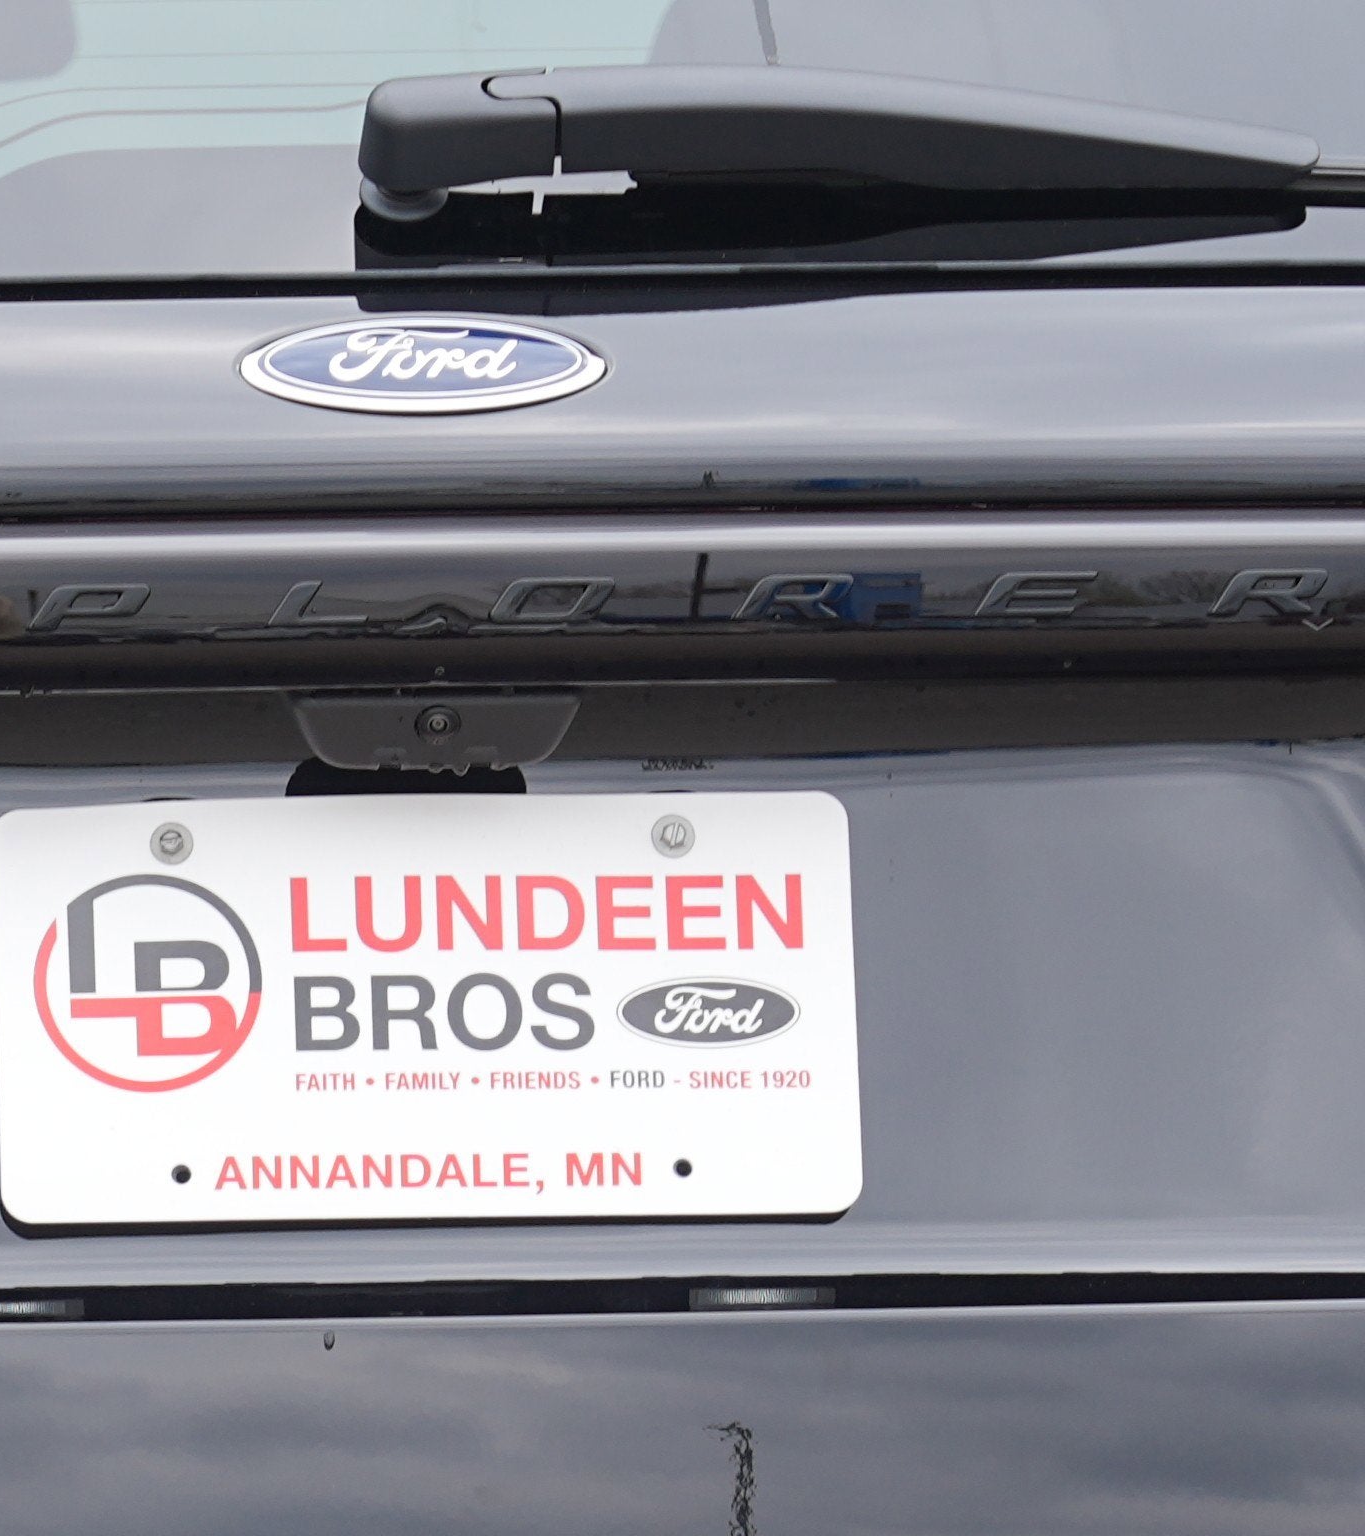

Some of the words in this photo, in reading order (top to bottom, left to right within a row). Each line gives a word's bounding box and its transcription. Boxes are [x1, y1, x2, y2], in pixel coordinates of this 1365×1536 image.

[328, 327, 518, 382] Ford
[289, 873, 805, 953] LUNDEEN
[295, 971, 596, 1053] BROS
[654, 989, 764, 1035] Ford
[295, 1072, 357, 1091] FAITH
[384, 1072, 460, 1091] FAMILY
[489, 1071, 581, 1090] FRIENDS
[609, 1070, 666, 1089] FORD
[689, 1070, 752, 1089] SINCE
[759, 1070, 811, 1089] 1920
[214, 1154, 546, 1195] ANNANDALE,
[566, 1152, 644, 1187] MN
